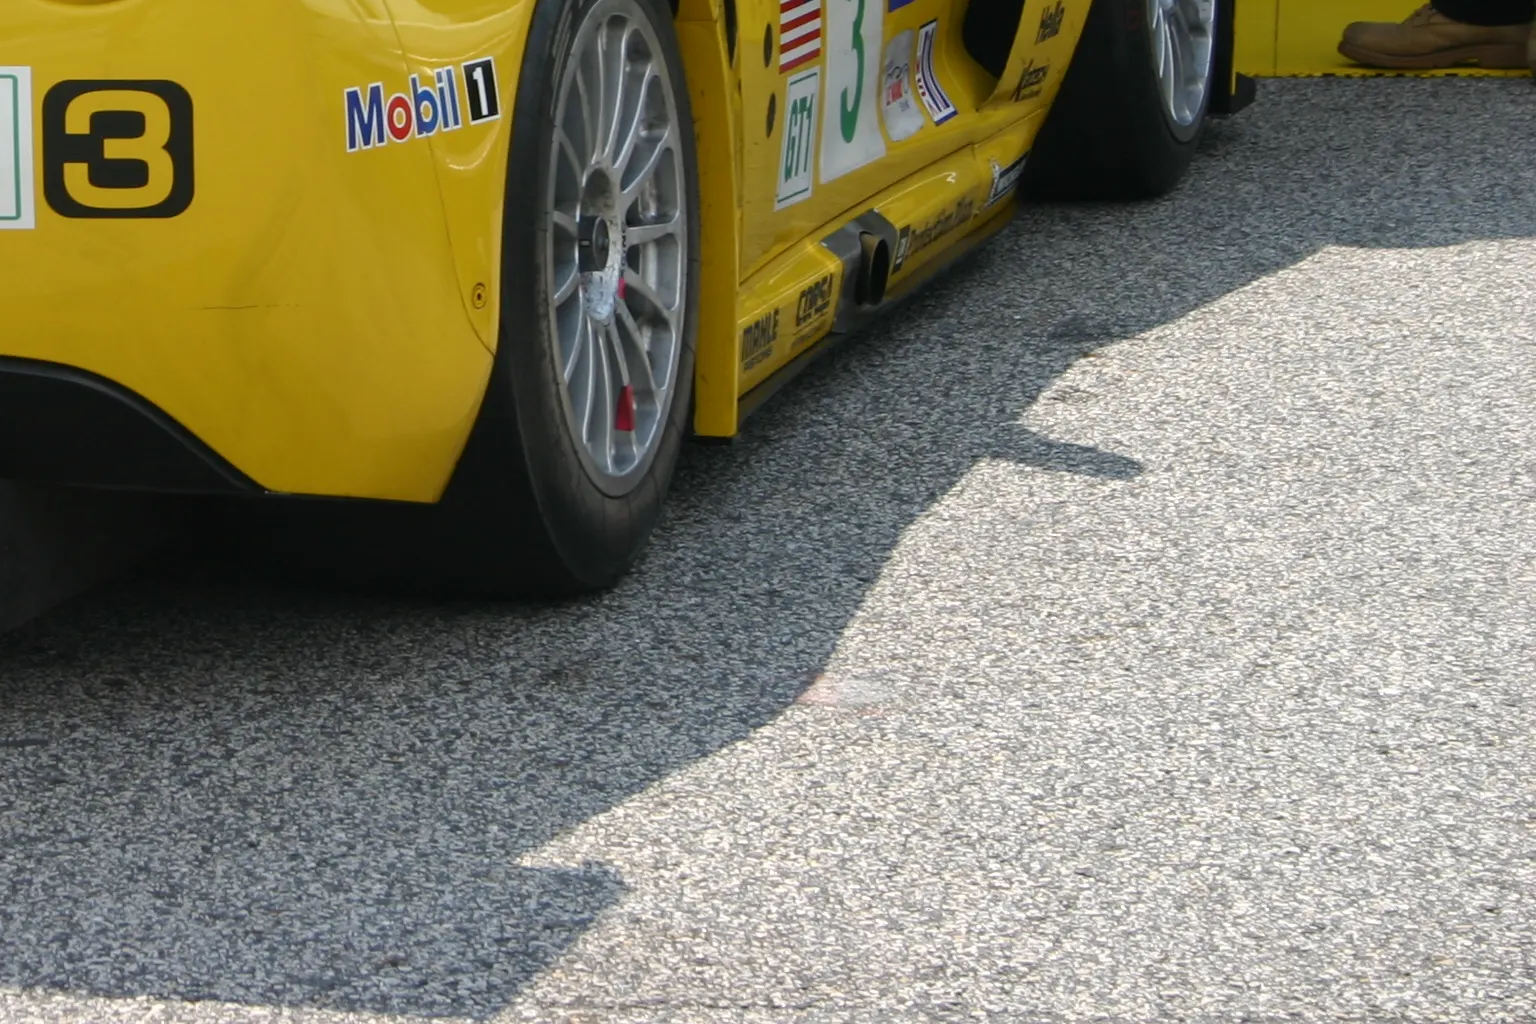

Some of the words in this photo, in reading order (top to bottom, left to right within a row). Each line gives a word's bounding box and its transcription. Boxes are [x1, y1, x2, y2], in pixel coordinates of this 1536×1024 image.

[61, 88, 176, 210] 3
[344, 65, 461, 153] Mobil
[783, 93, 815, 183] GT1
